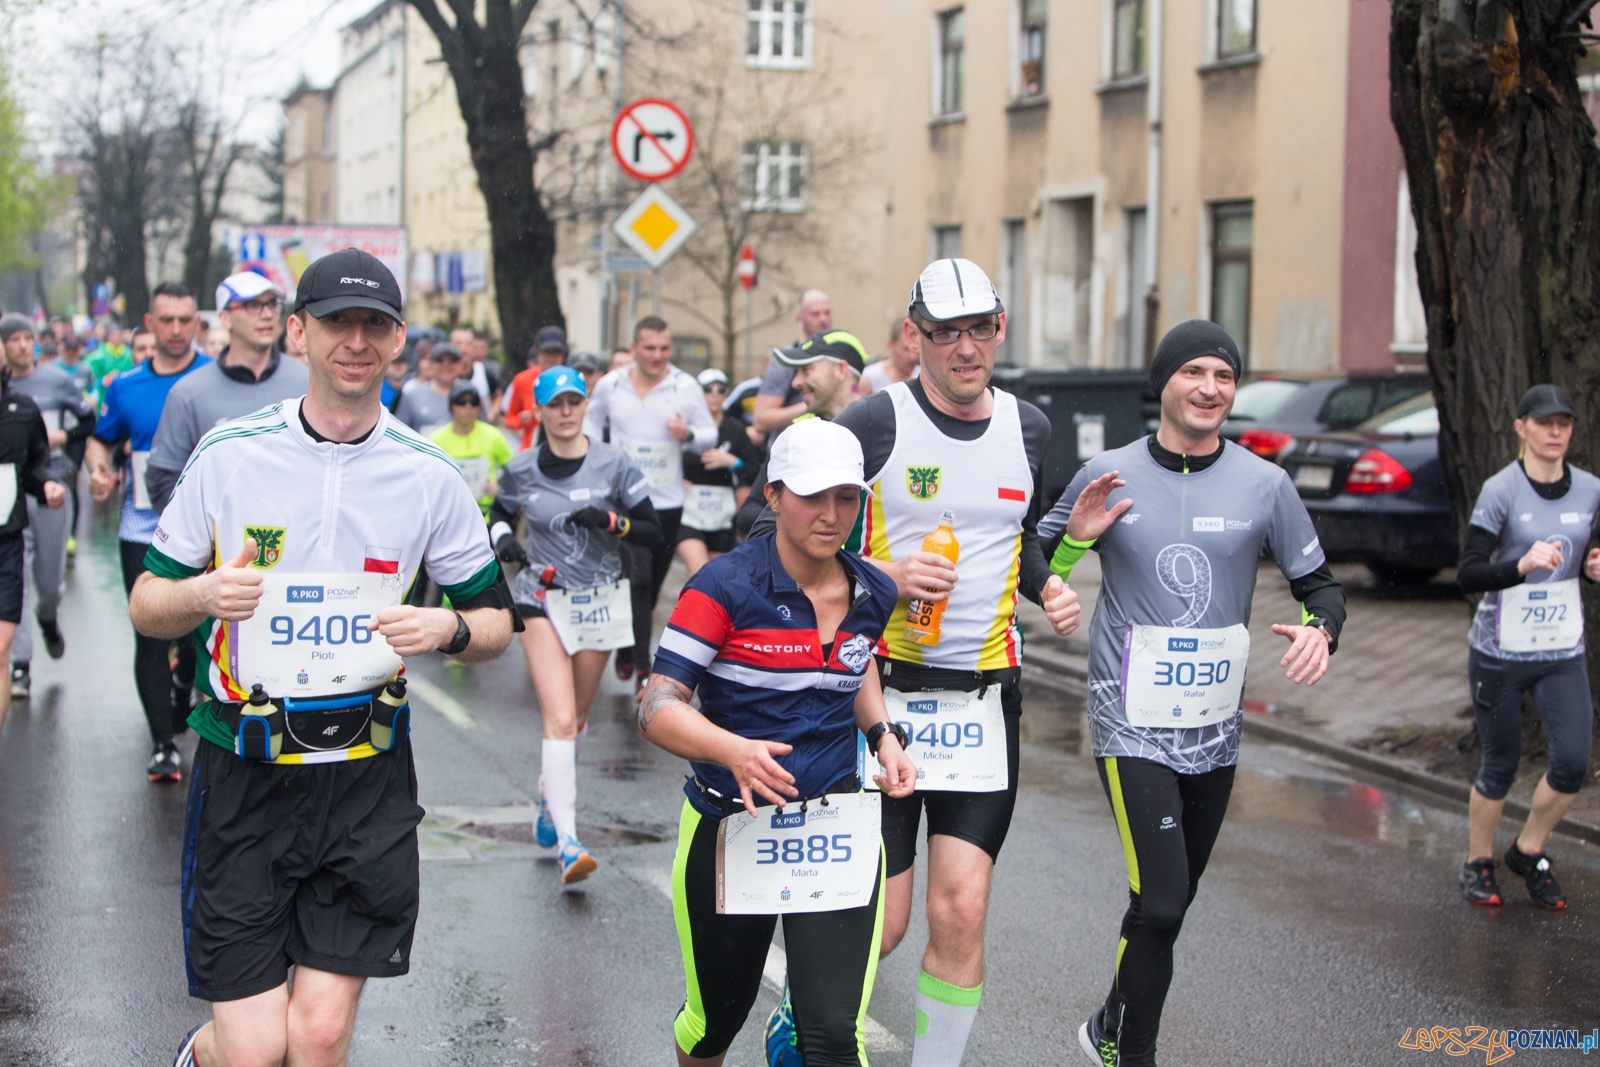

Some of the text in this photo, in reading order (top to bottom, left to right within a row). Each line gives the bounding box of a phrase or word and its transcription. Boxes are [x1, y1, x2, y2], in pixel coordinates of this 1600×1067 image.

[1120, 514, 1140, 524] 4F
[1155, 543, 1212, 628] 9
[300, 591, 319, 599] PKO
[570, 606, 610, 625] 3411
[1521, 604, 1567, 624] 7972
[270, 615, 373, 646] 9406
[743, 643, 812, 653] FACTORY
[1179, 641, 1194, 649] PKO
[311, 651, 335, 660] Piotr
[1154, 660, 1231, 686] 3030
[918, 703, 933, 711] PKO
[322, 725, 340, 736] 4F
[923, 751, 953, 760] Michał
[784, 816, 801, 825] PKO
[757, 834, 852, 864] 3885
[791, 869, 818, 877] Marta
